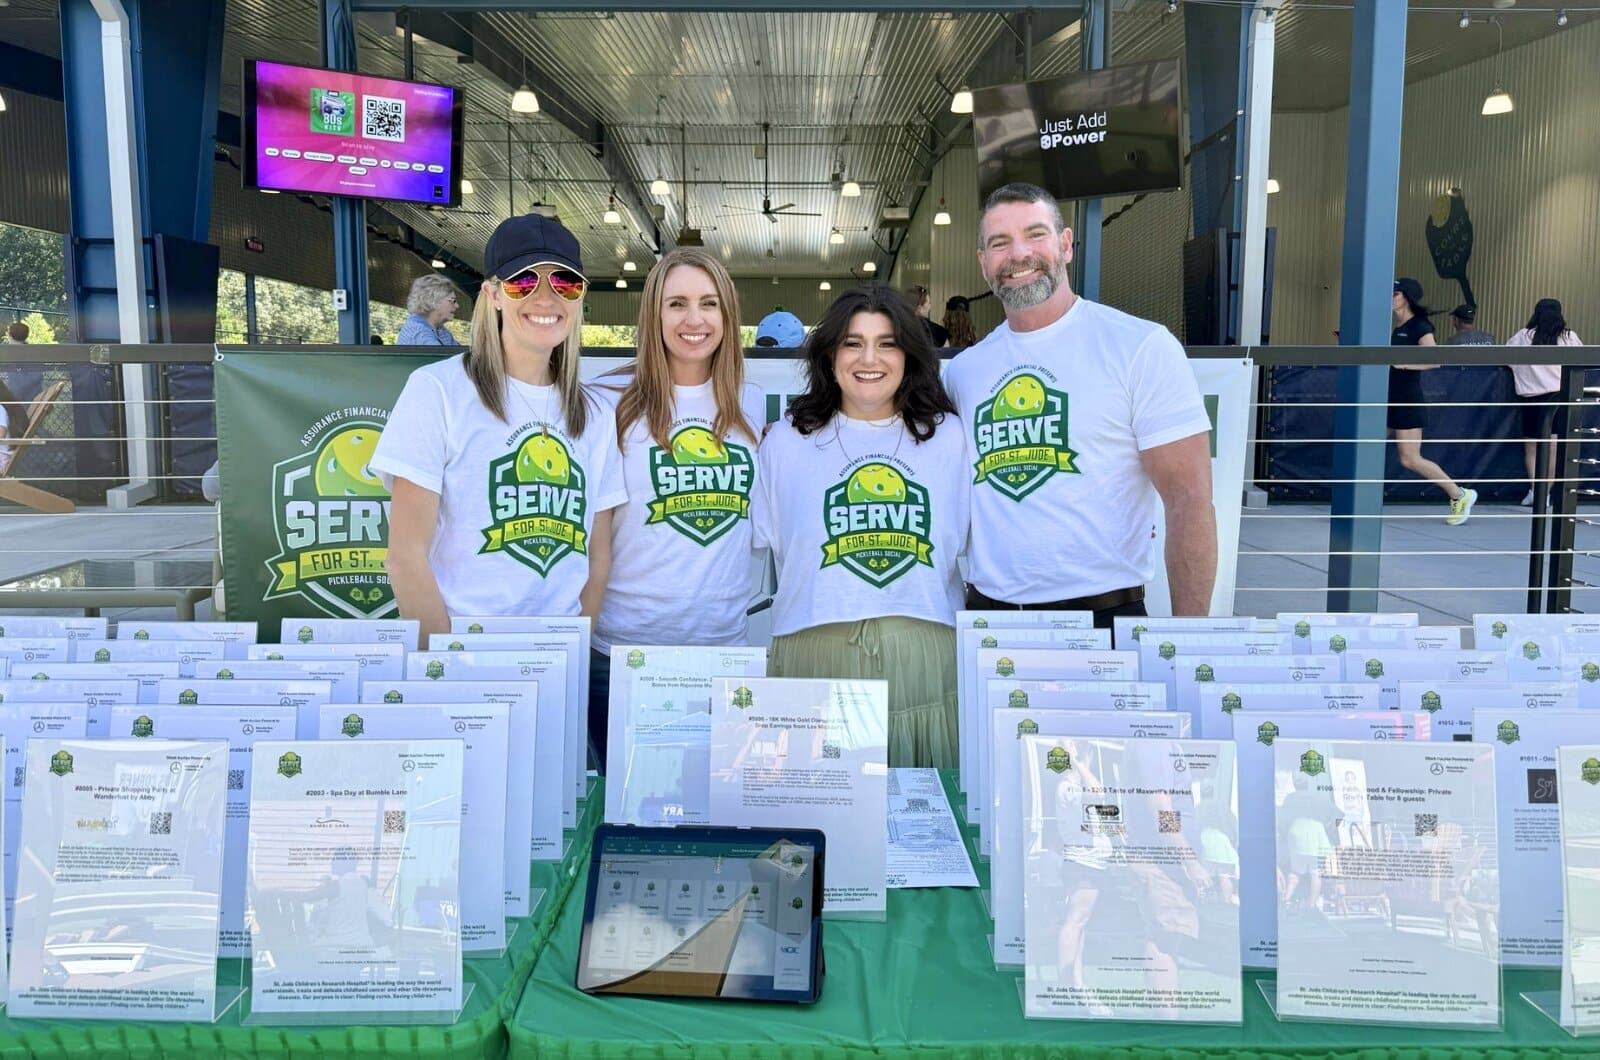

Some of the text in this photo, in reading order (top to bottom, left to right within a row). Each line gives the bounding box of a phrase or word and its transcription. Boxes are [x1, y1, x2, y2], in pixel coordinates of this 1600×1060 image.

[323, 113, 342, 126] 80s
[1040, 111, 1107, 135] Just Add
[1052, 130, 1107, 149] Power
[301, 410, 343, 447] ASSURANCE
[978, 414, 1063, 455] SERVE
[989, 453, 1006, 466] FOR
[1027, 449, 1050, 461] JUDE
[656, 464, 750, 496] SERVE
[496, 484, 582, 524] SERVE
[673, 495, 737, 509] FOR ST. JUDE
[285, 500, 391, 550] SER
[512, 520, 535, 536] FOR
[829, 503, 926, 537] SERVE
[846, 534, 912, 549] FOR ST. JUDE
[311, 551, 343, 572] FOR
[350, 550, 373, 569] ST.
[328, 575, 391, 586] PICKLEBALL SOC
[330, 789, 343, 798] Spa
[344, 789, 356, 798] Day
[366, 788, 390, 796] Bumble
